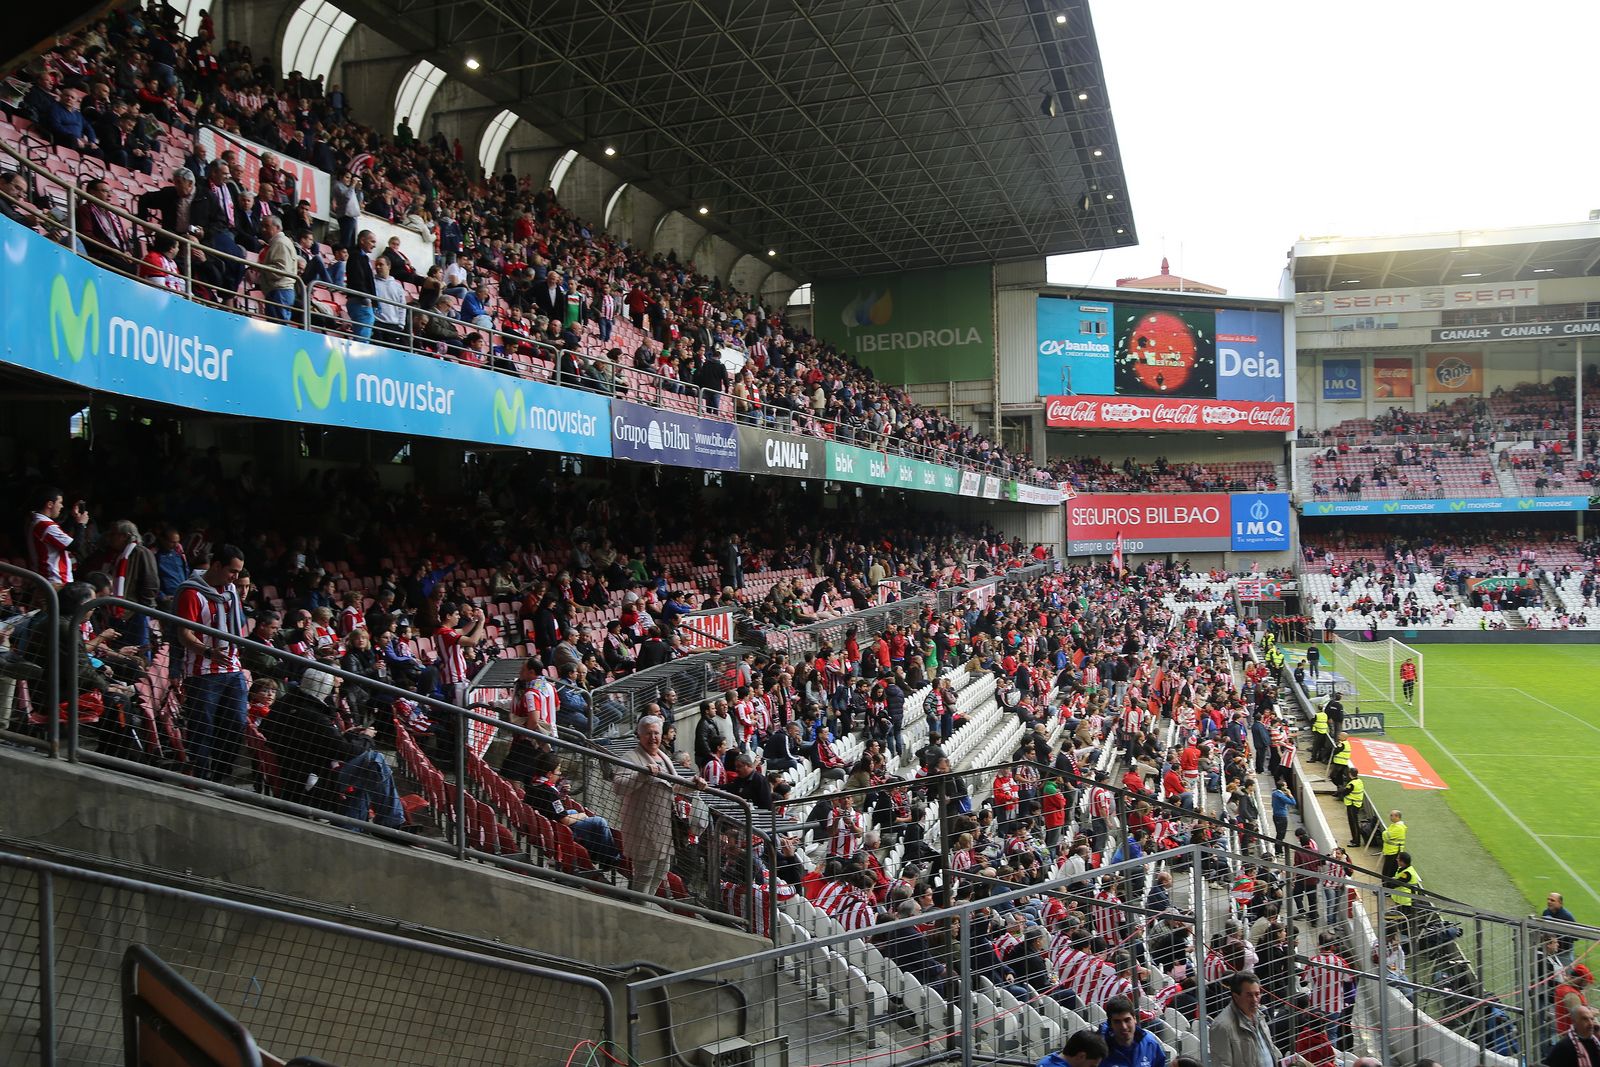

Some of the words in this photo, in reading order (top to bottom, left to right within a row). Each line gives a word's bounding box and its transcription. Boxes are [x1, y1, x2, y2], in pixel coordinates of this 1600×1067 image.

[1333, 294, 1411, 309] SEAT
[1454, 287, 1535, 302] SEAT
[856, 327, 983, 353] IBERDROLA
[1440, 328, 1490, 340] CANAL+
[1501, 325, 1552, 337] CANAL+
[109, 316, 233, 382] movistar
[1065, 339, 1110, 353] bankoa
[1219, 348, 1281, 378] Deia
[356, 373, 455, 415] movistar
[1325, 378, 1357, 391] IMQ
[530, 405, 597, 436] movistar
[1047, 400, 1099, 422] Coca-Cola
[1152, 403, 1199, 424] Coca-Cola
[1248, 406, 1293, 426] Coca-Cola
[613, 415, 648, 450] Grupo
[663, 421, 690, 450] bilbu
[765, 438, 809, 470] CANAL+
[834, 451, 854, 473] bbk
[870, 459, 886, 478] bbk
[900, 464, 913, 482] bbk
[1072, 507, 1141, 526] SEGUROS
[1146, 506, 1220, 525] BILBAO
[1236, 520, 1285, 537] IMQ
[1073, 540, 1102, 554] siempre
[1105, 538, 1144, 553] cotigo
[1343, 716, 1382, 731] BBVA
